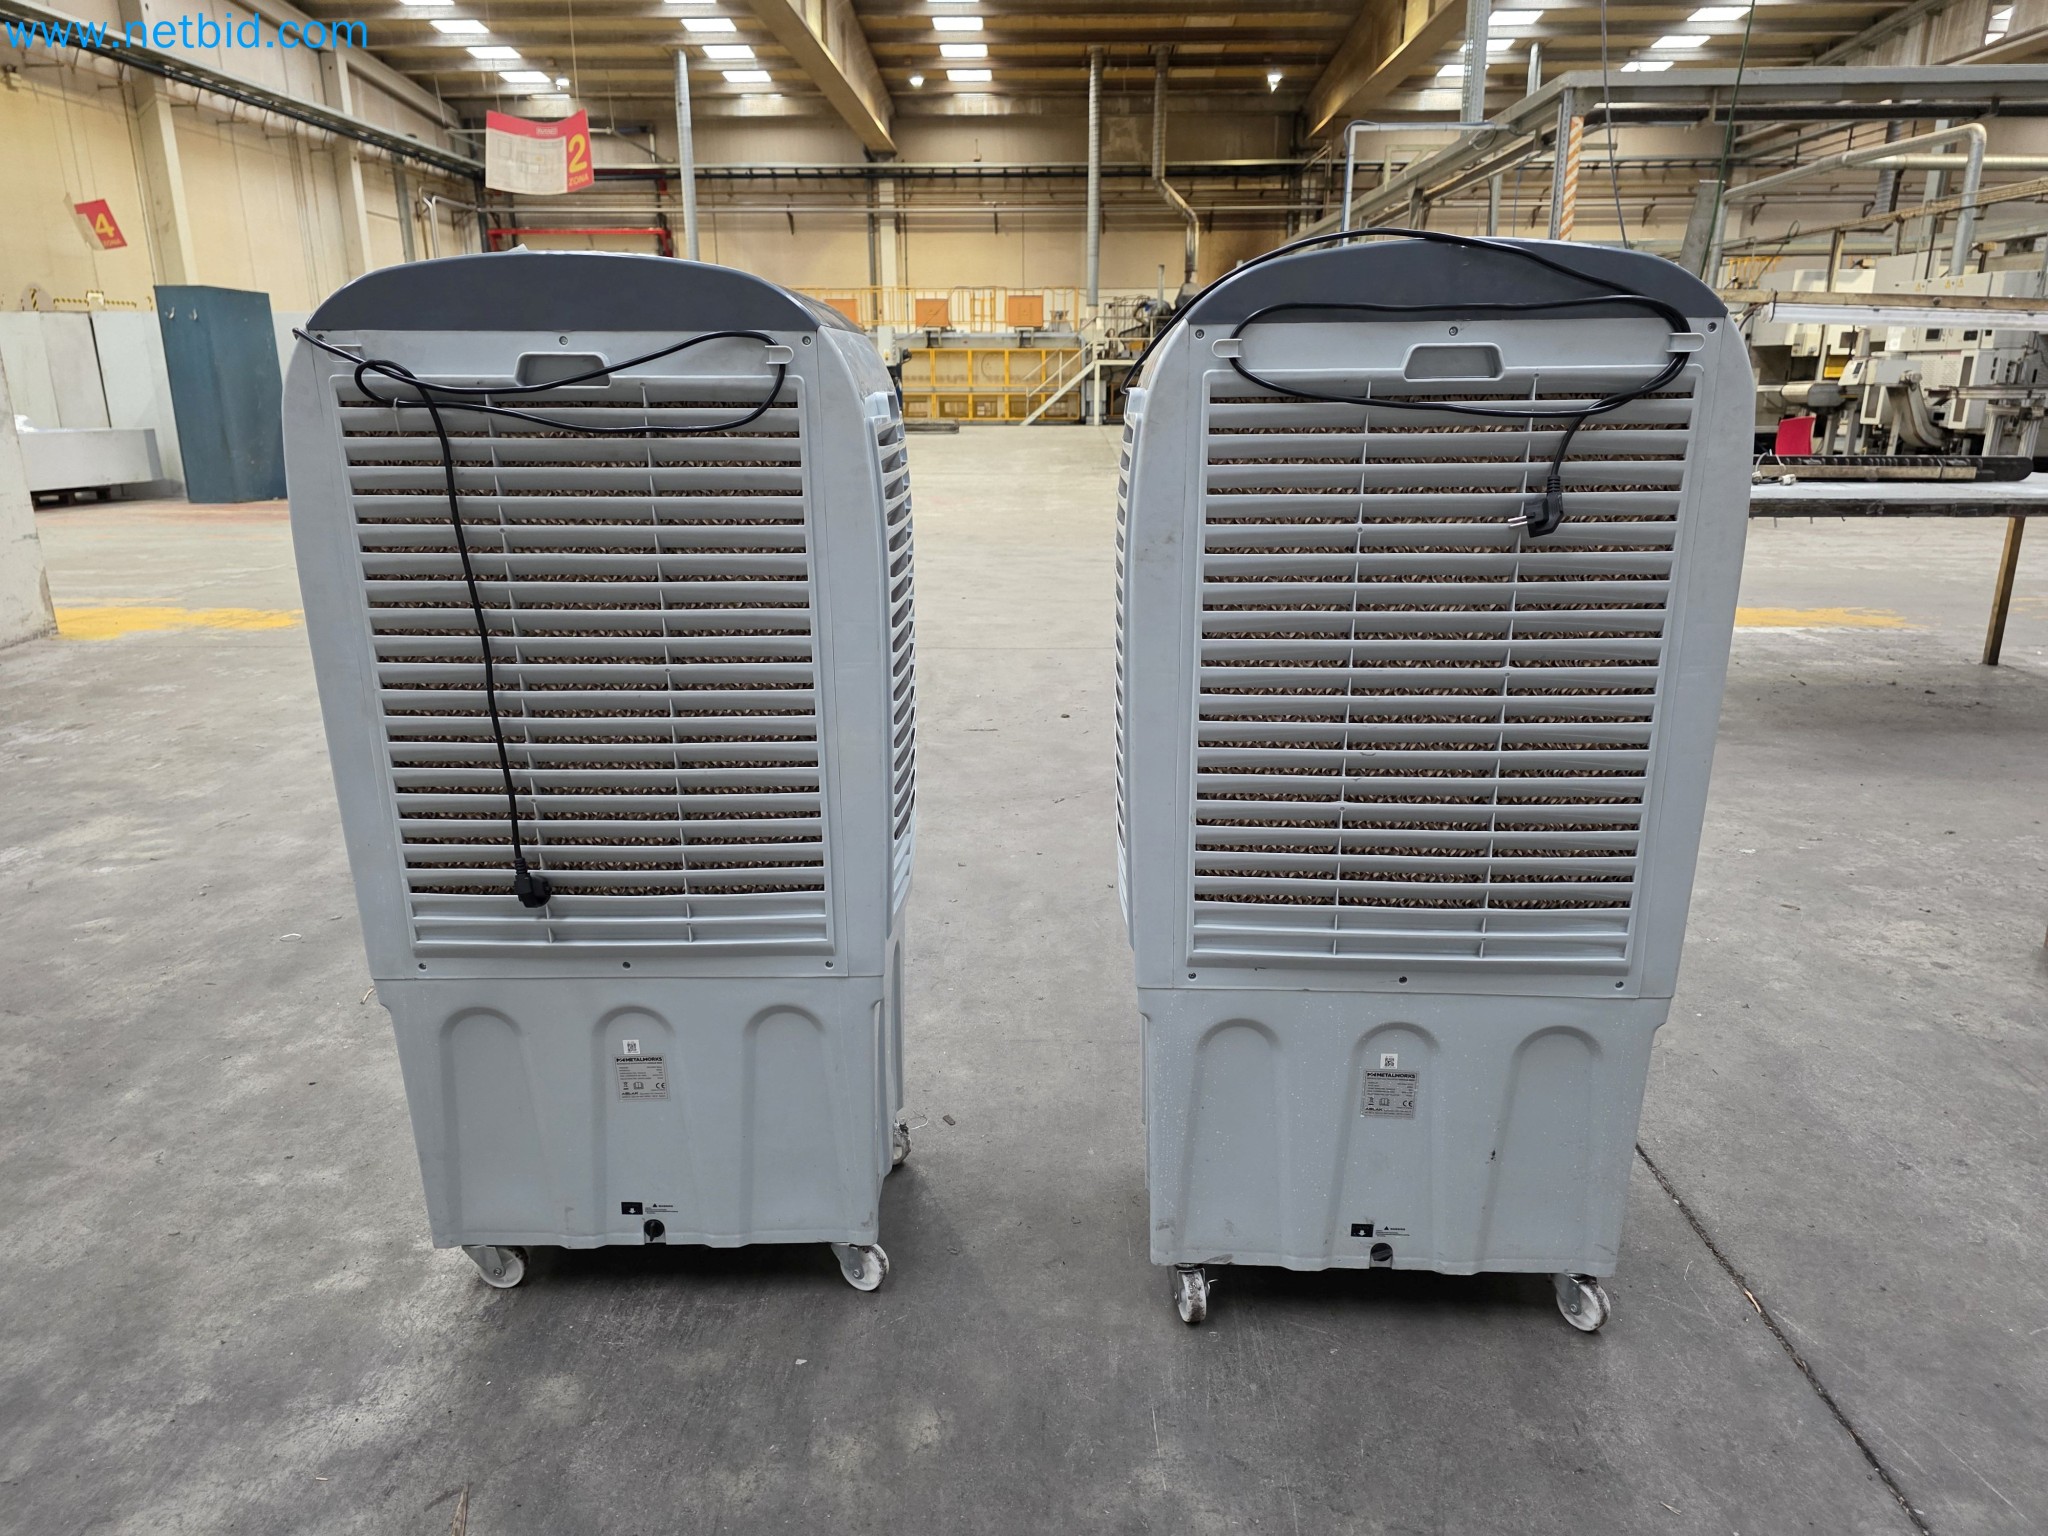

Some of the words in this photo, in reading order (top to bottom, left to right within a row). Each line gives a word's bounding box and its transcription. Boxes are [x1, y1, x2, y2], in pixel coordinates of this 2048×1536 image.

[569, 133, 587, 173] 2
[568, 173, 589, 186] ZONA
[95, 212, 114, 237] 4
